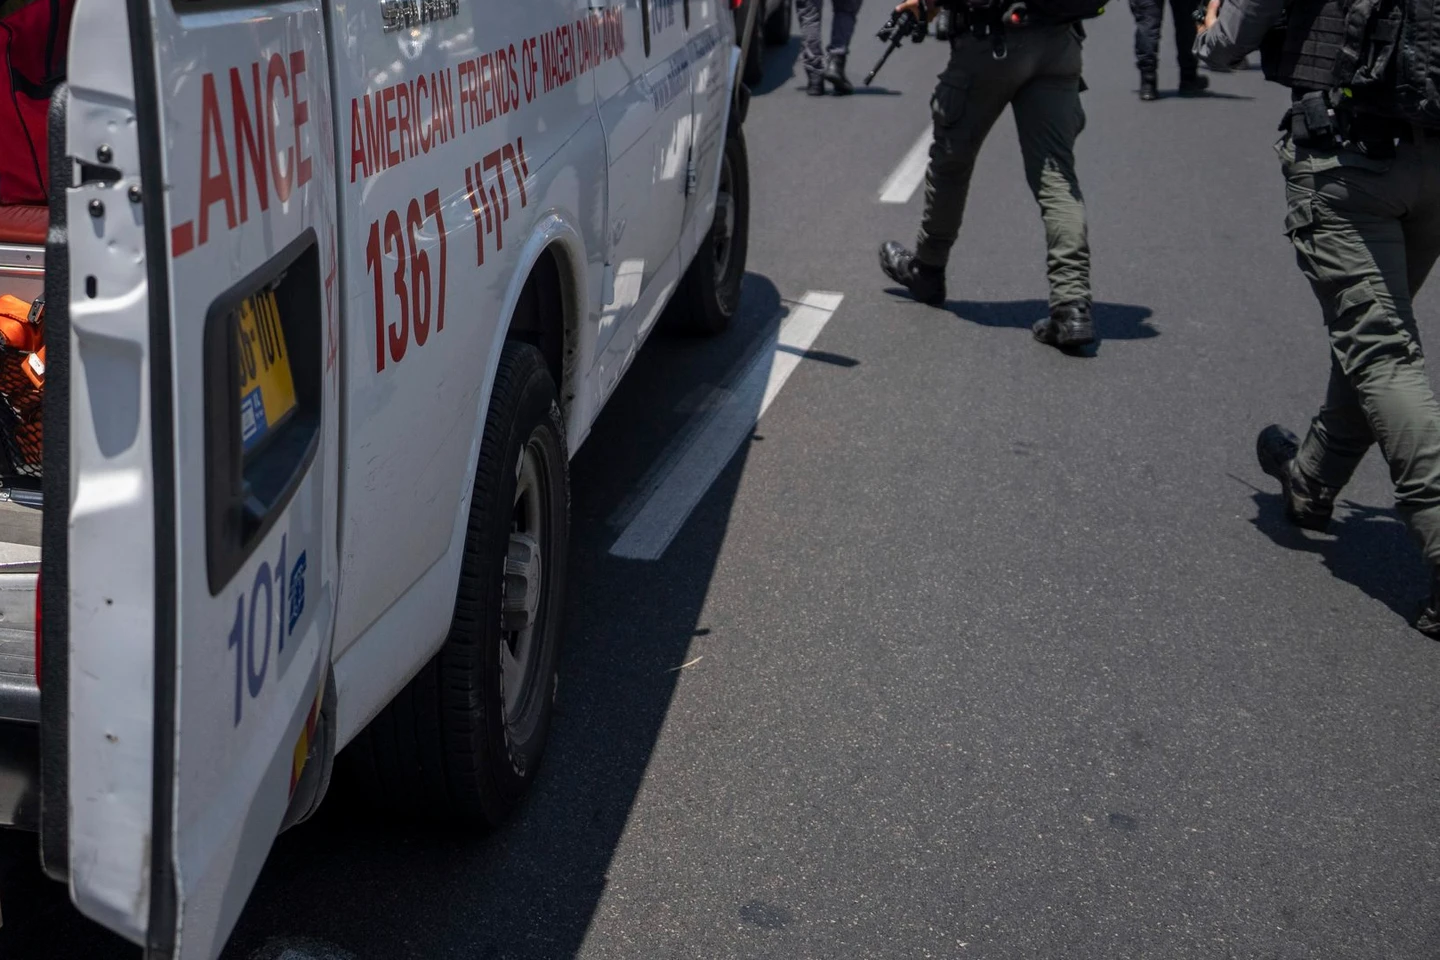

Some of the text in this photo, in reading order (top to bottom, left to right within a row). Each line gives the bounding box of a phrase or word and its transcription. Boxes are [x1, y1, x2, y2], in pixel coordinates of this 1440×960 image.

[350, 68, 460, 183] AMERICAN
[458, 42, 520, 134] FRIENDS
[522, 37, 538, 102] OF
[540, 23, 577, 93] MAGEN
[577, 11, 601, 75] DAVID
[366, 187, 447, 374] 1367
[465, 136, 529, 267] ירקון
[228, 532, 287, 729] 101
